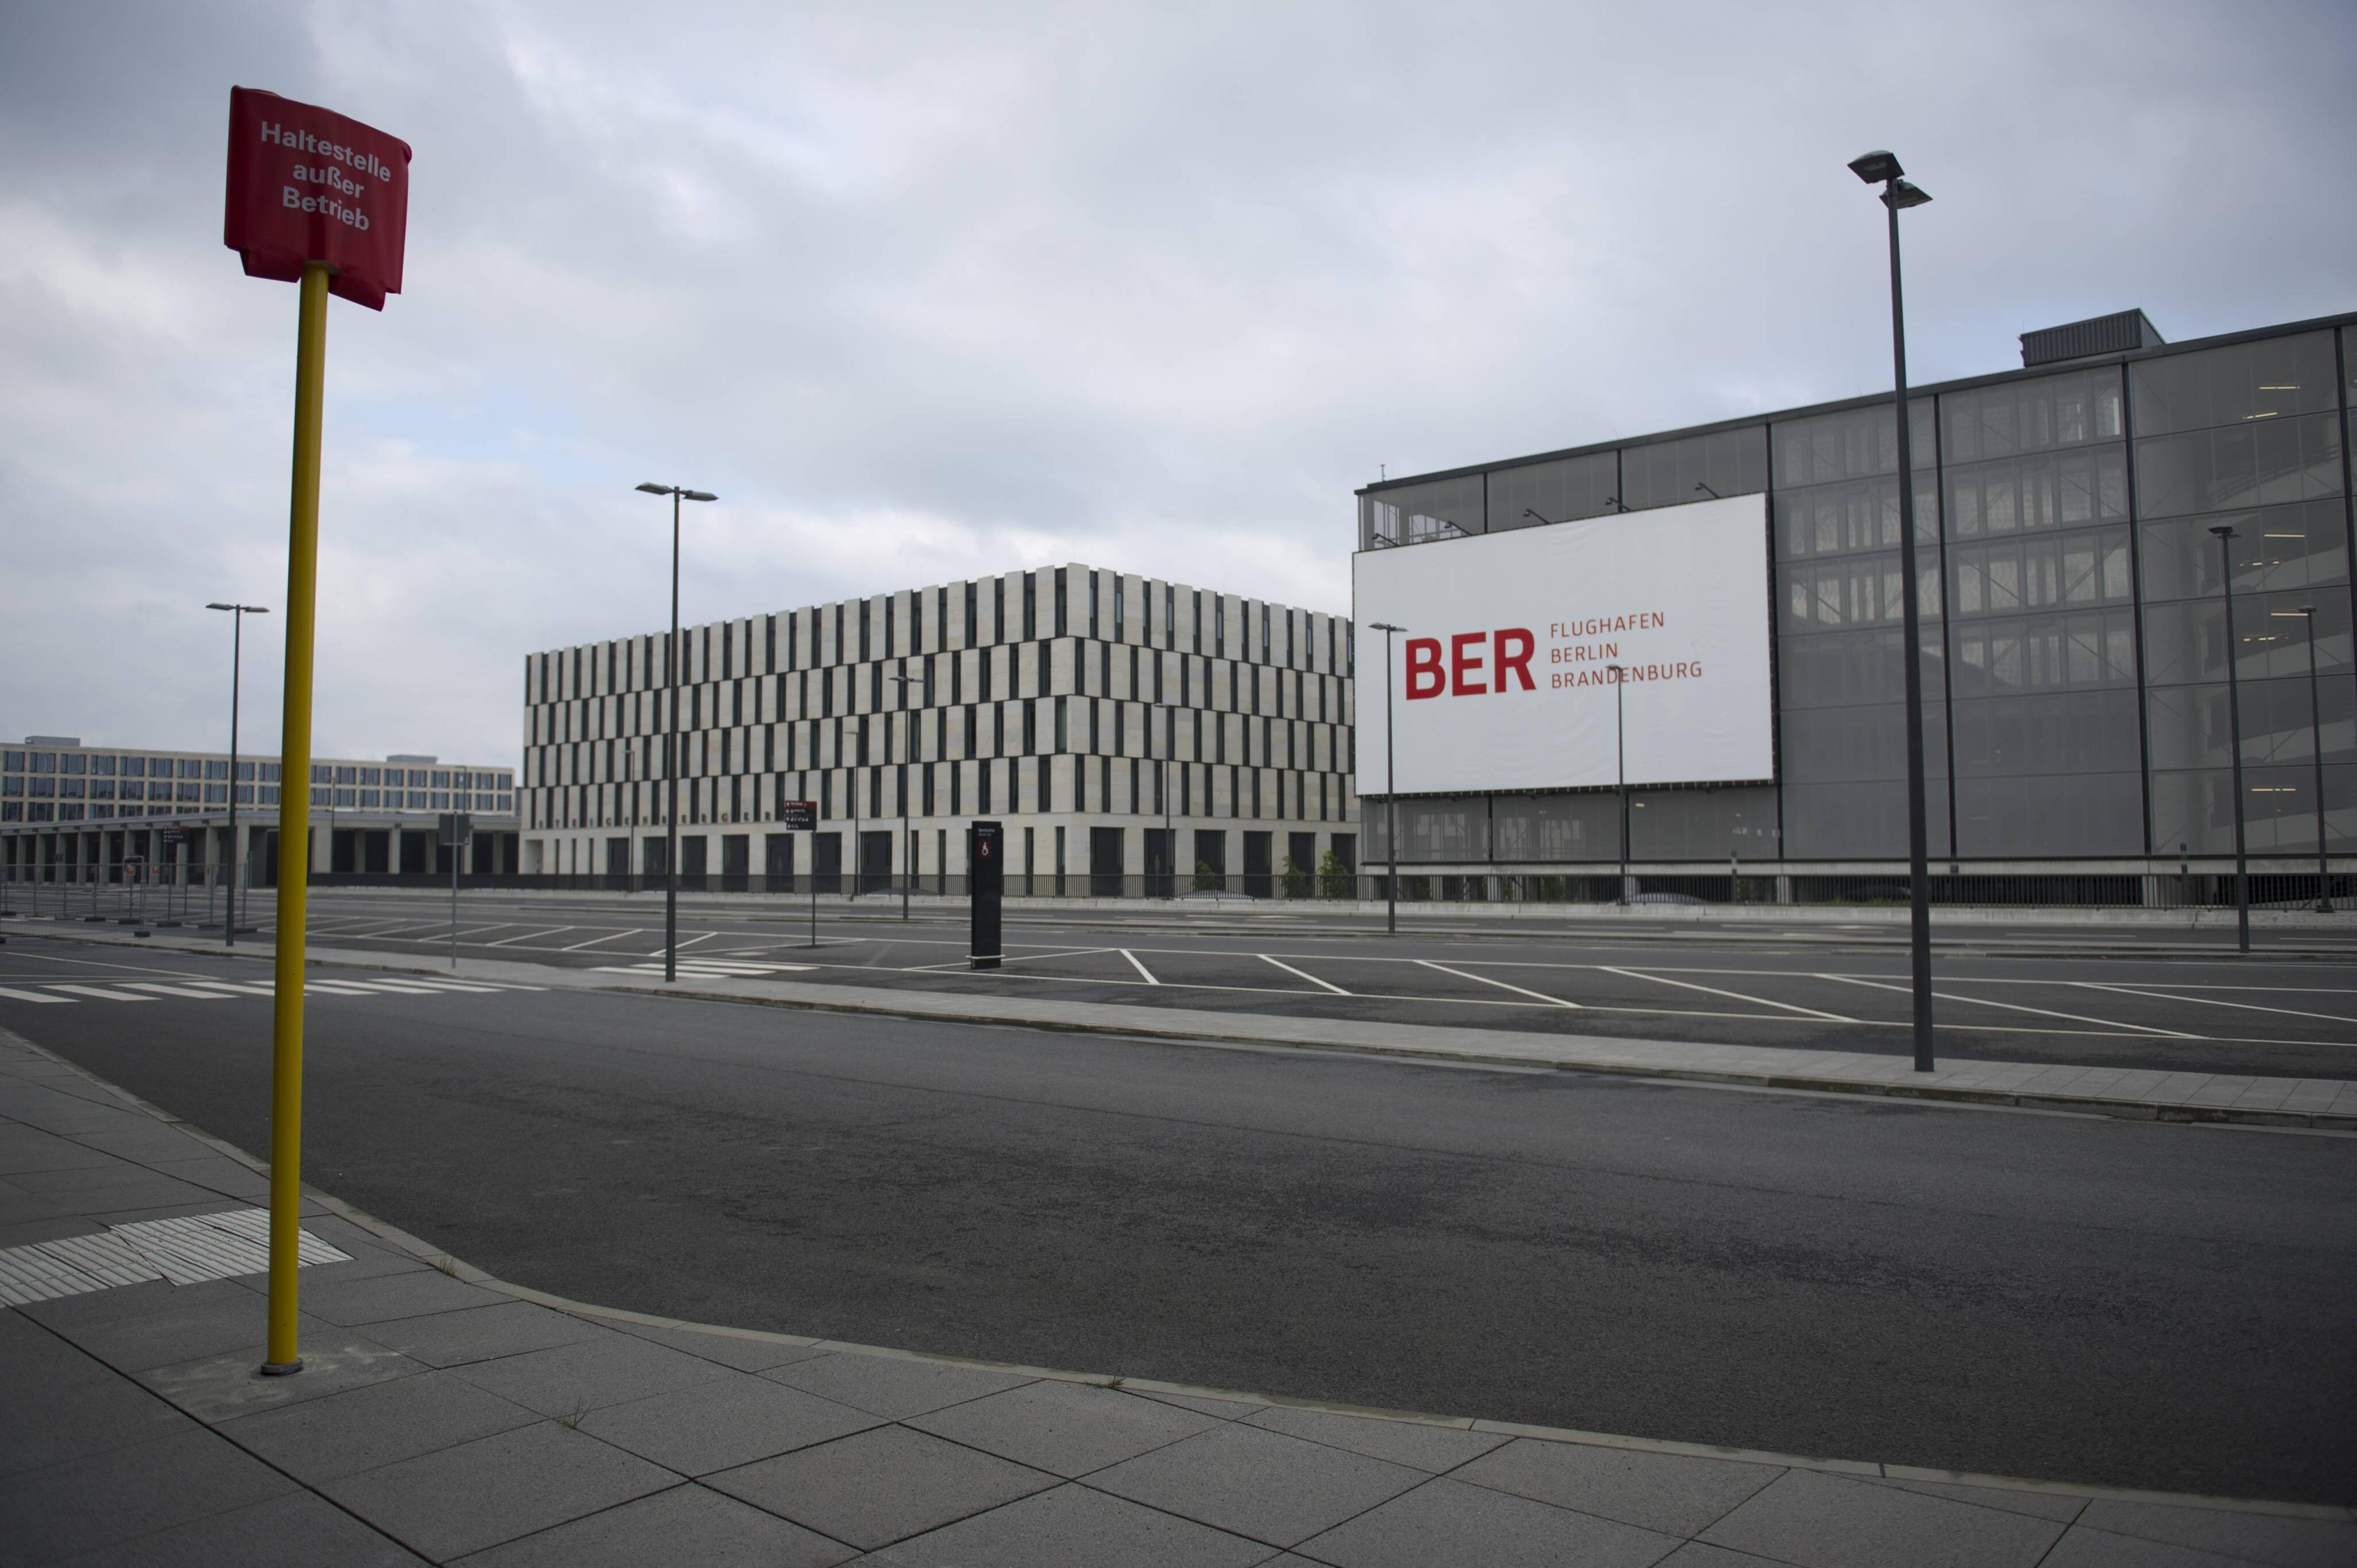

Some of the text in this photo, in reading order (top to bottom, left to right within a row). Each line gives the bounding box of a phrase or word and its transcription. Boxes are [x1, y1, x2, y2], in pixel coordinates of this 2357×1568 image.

[261, 121, 391, 183] Haltestelle
[293, 164, 365, 199] außer
[283, 186, 369, 231] Betrieb
[1550, 612, 1664, 638] FLUGHAFEN
[1405, 628, 1537, 701] BER
[1551, 642, 1618, 663] BERLIN
[1551, 661, 1702, 688] BRANDENBURG
